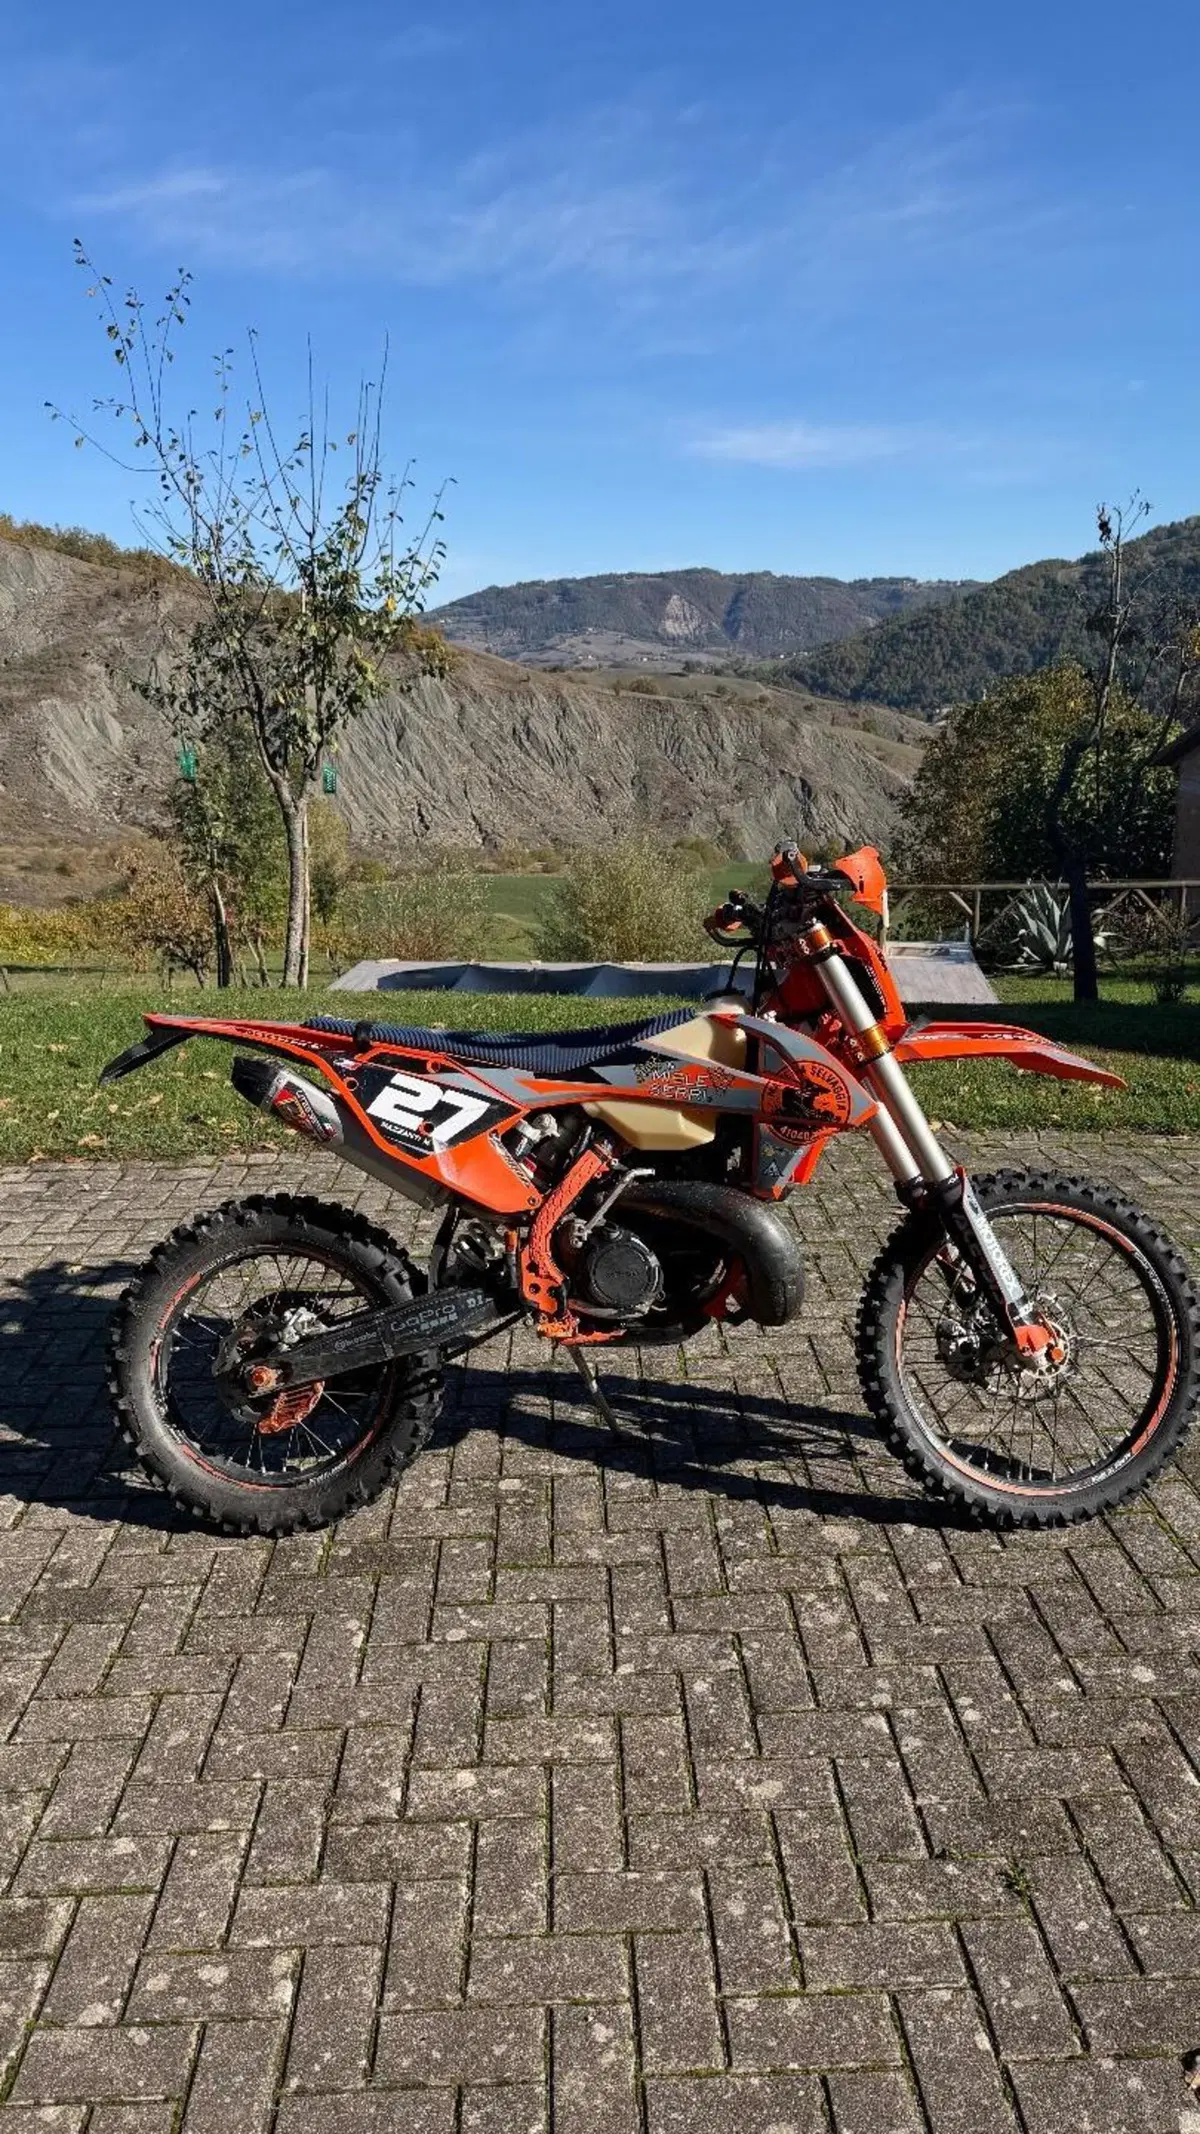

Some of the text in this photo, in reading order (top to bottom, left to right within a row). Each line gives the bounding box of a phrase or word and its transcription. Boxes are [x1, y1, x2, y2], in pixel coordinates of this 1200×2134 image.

[365, 1072, 491, 1143] 27
[810, 1064, 847, 1111] SELVAGGIA
[389, 1303, 455, 1333] GoPro
